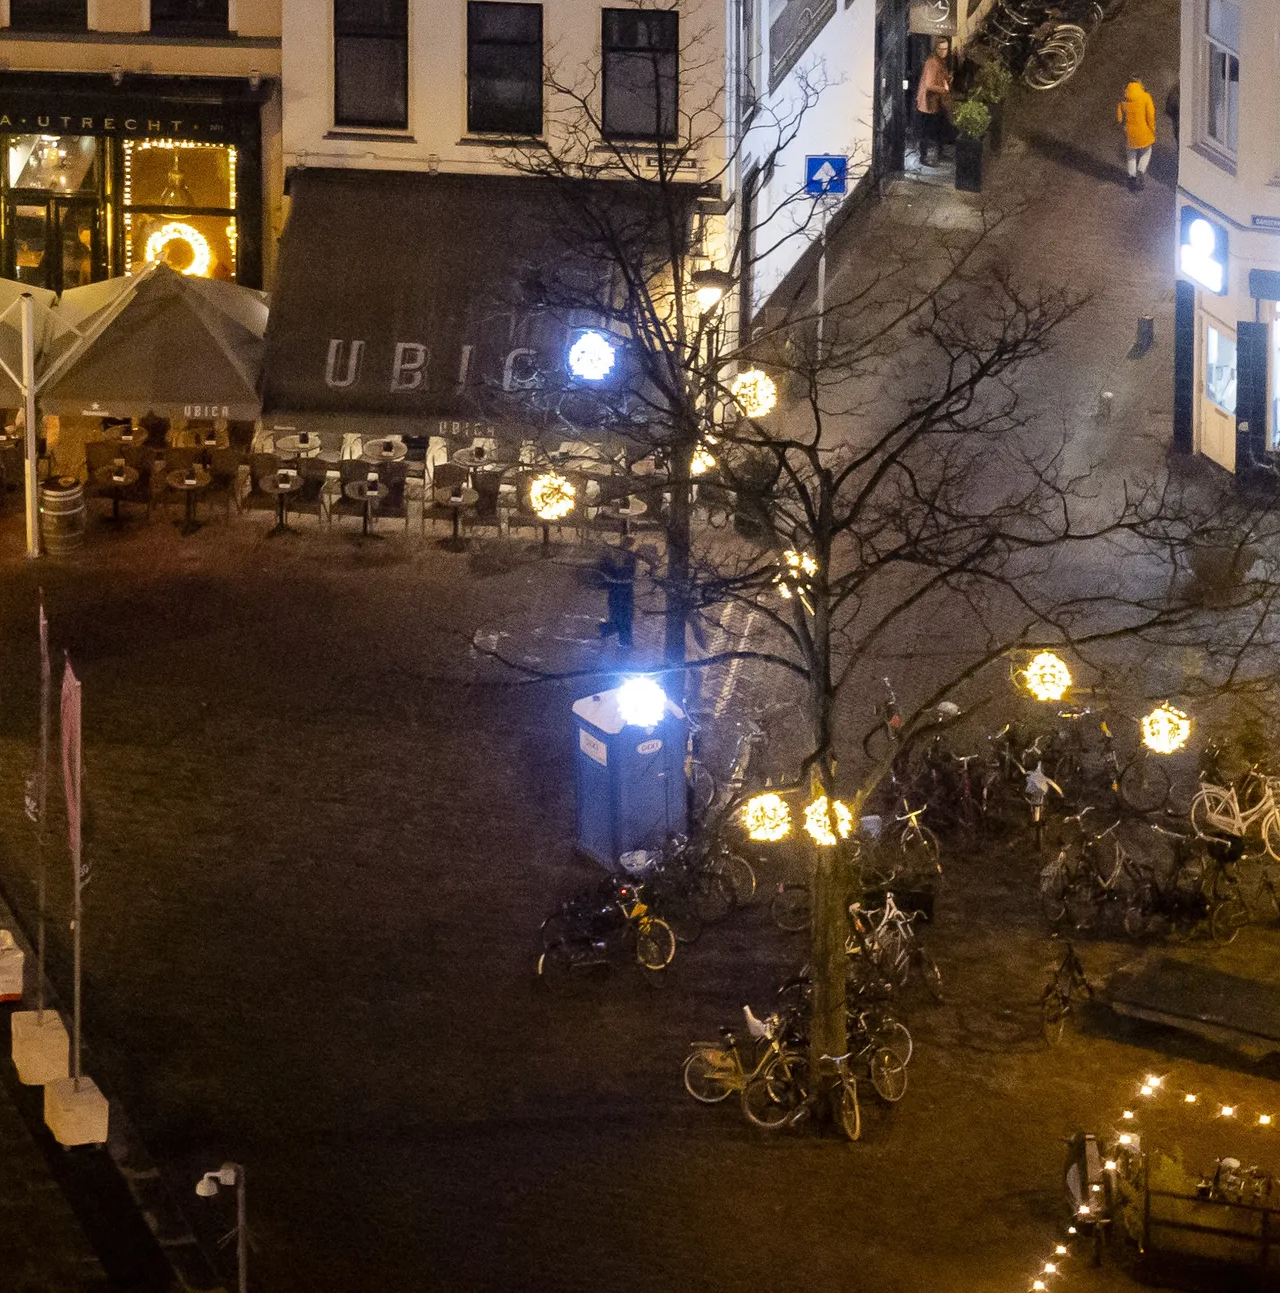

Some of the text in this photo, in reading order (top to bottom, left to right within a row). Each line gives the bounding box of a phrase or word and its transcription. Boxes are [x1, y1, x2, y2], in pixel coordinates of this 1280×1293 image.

[36, 115, 184, 132] UTRECHT
[323, 337, 605, 395] UBIC
[183, 405, 229, 418] UBICA
[438, 420, 495, 437] UBICA
